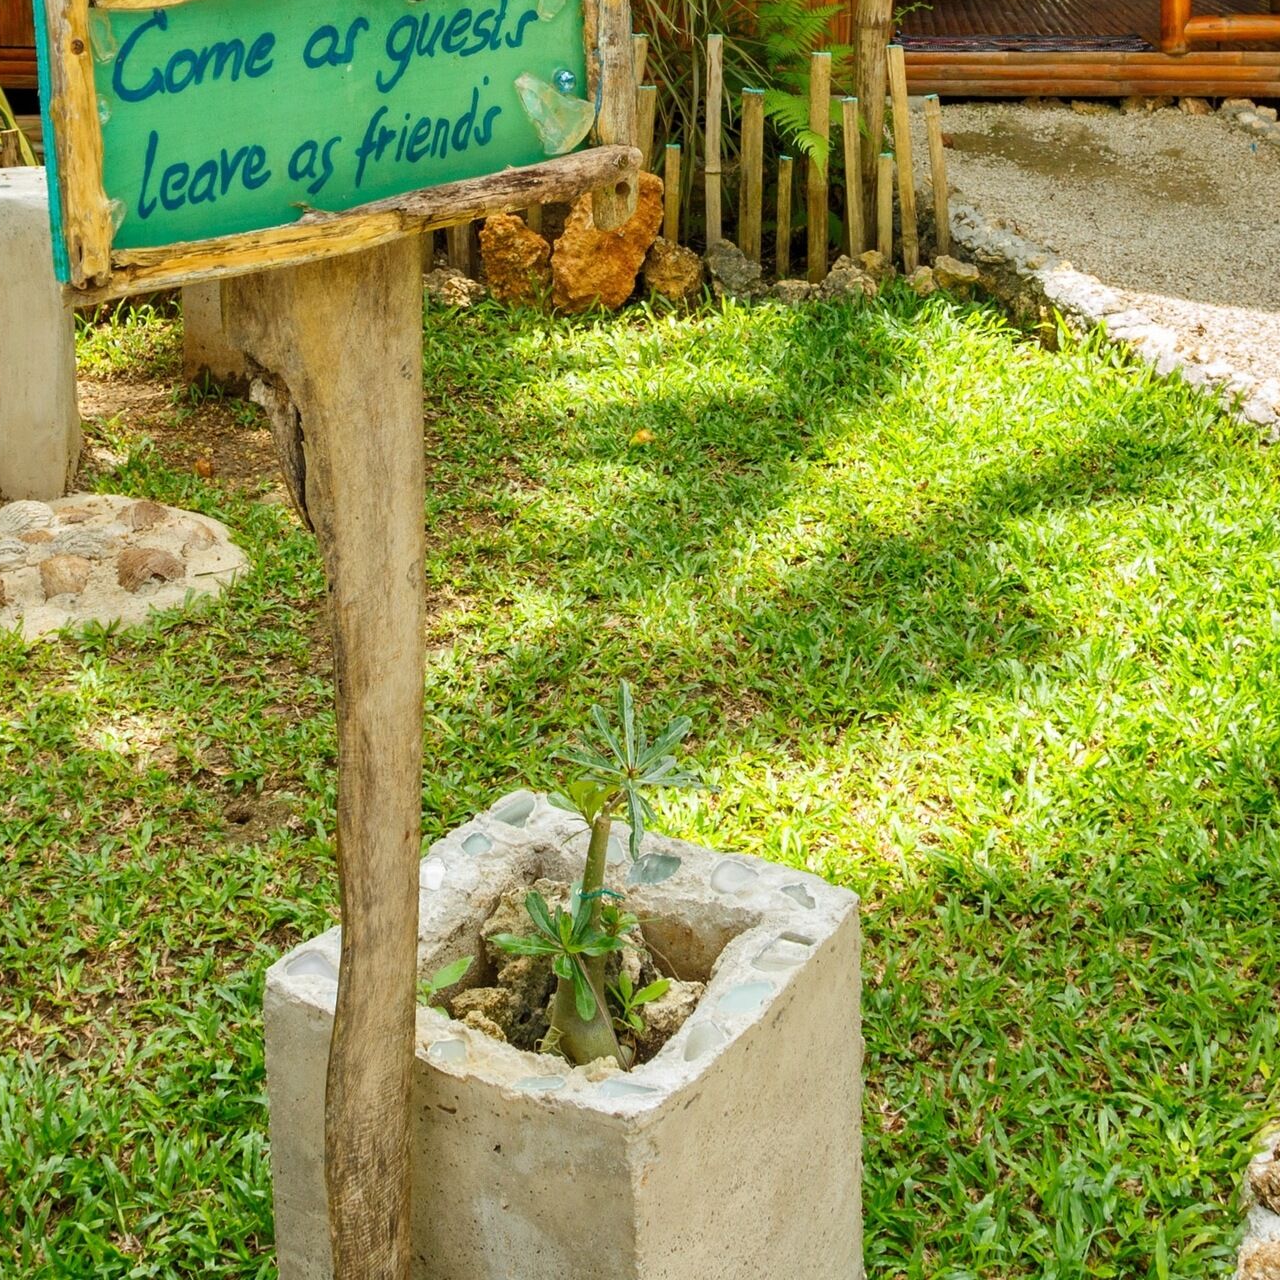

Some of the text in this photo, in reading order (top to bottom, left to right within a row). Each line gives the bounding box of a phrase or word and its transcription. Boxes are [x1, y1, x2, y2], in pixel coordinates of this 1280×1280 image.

[112, 8, 275, 103] Come
[303, 17, 368, 69] as
[137, 131, 271, 219] leave
[288, 135, 335, 195] as
